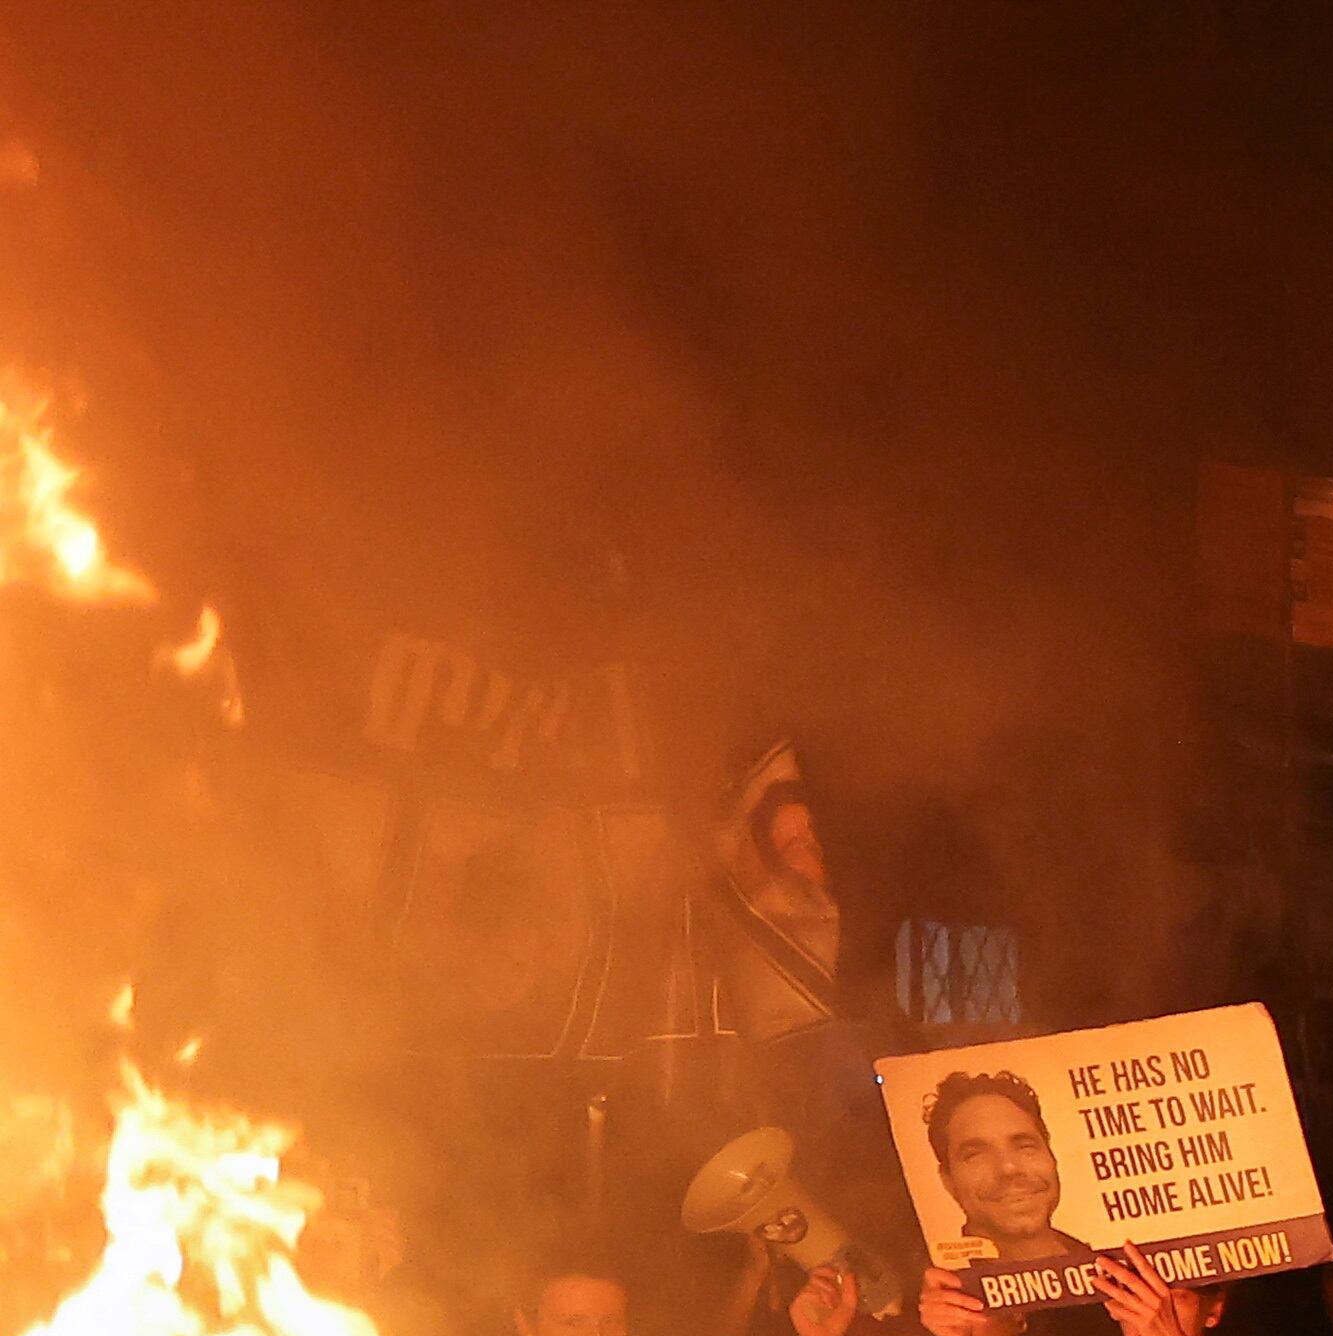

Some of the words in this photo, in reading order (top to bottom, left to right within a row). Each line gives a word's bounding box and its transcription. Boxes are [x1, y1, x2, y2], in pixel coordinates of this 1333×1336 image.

[1069, 1064, 1106, 1099] HE
[1111, 1056, 1165, 1092] HAS
[1170, 1049, 1210, 1083] NO
[1079, 1102, 1146, 1139] TIME
[1148, 1096, 1186, 1128] TO
[1190, 1083, 1266, 1122] WAIT.
[1090, 1141, 1174, 1181] BRING
[1178, 1131, 1233, 1167] HIM
[1102, 1182, 1183, 1221] HOME
[1189, 1167, 1273, 1209] ALIVE!
[981, 1269, 1063, 1308] BRING
[1148, 1246, 1217, 1283] OME
[1216, 1232, 1293, 1272] NOW!
